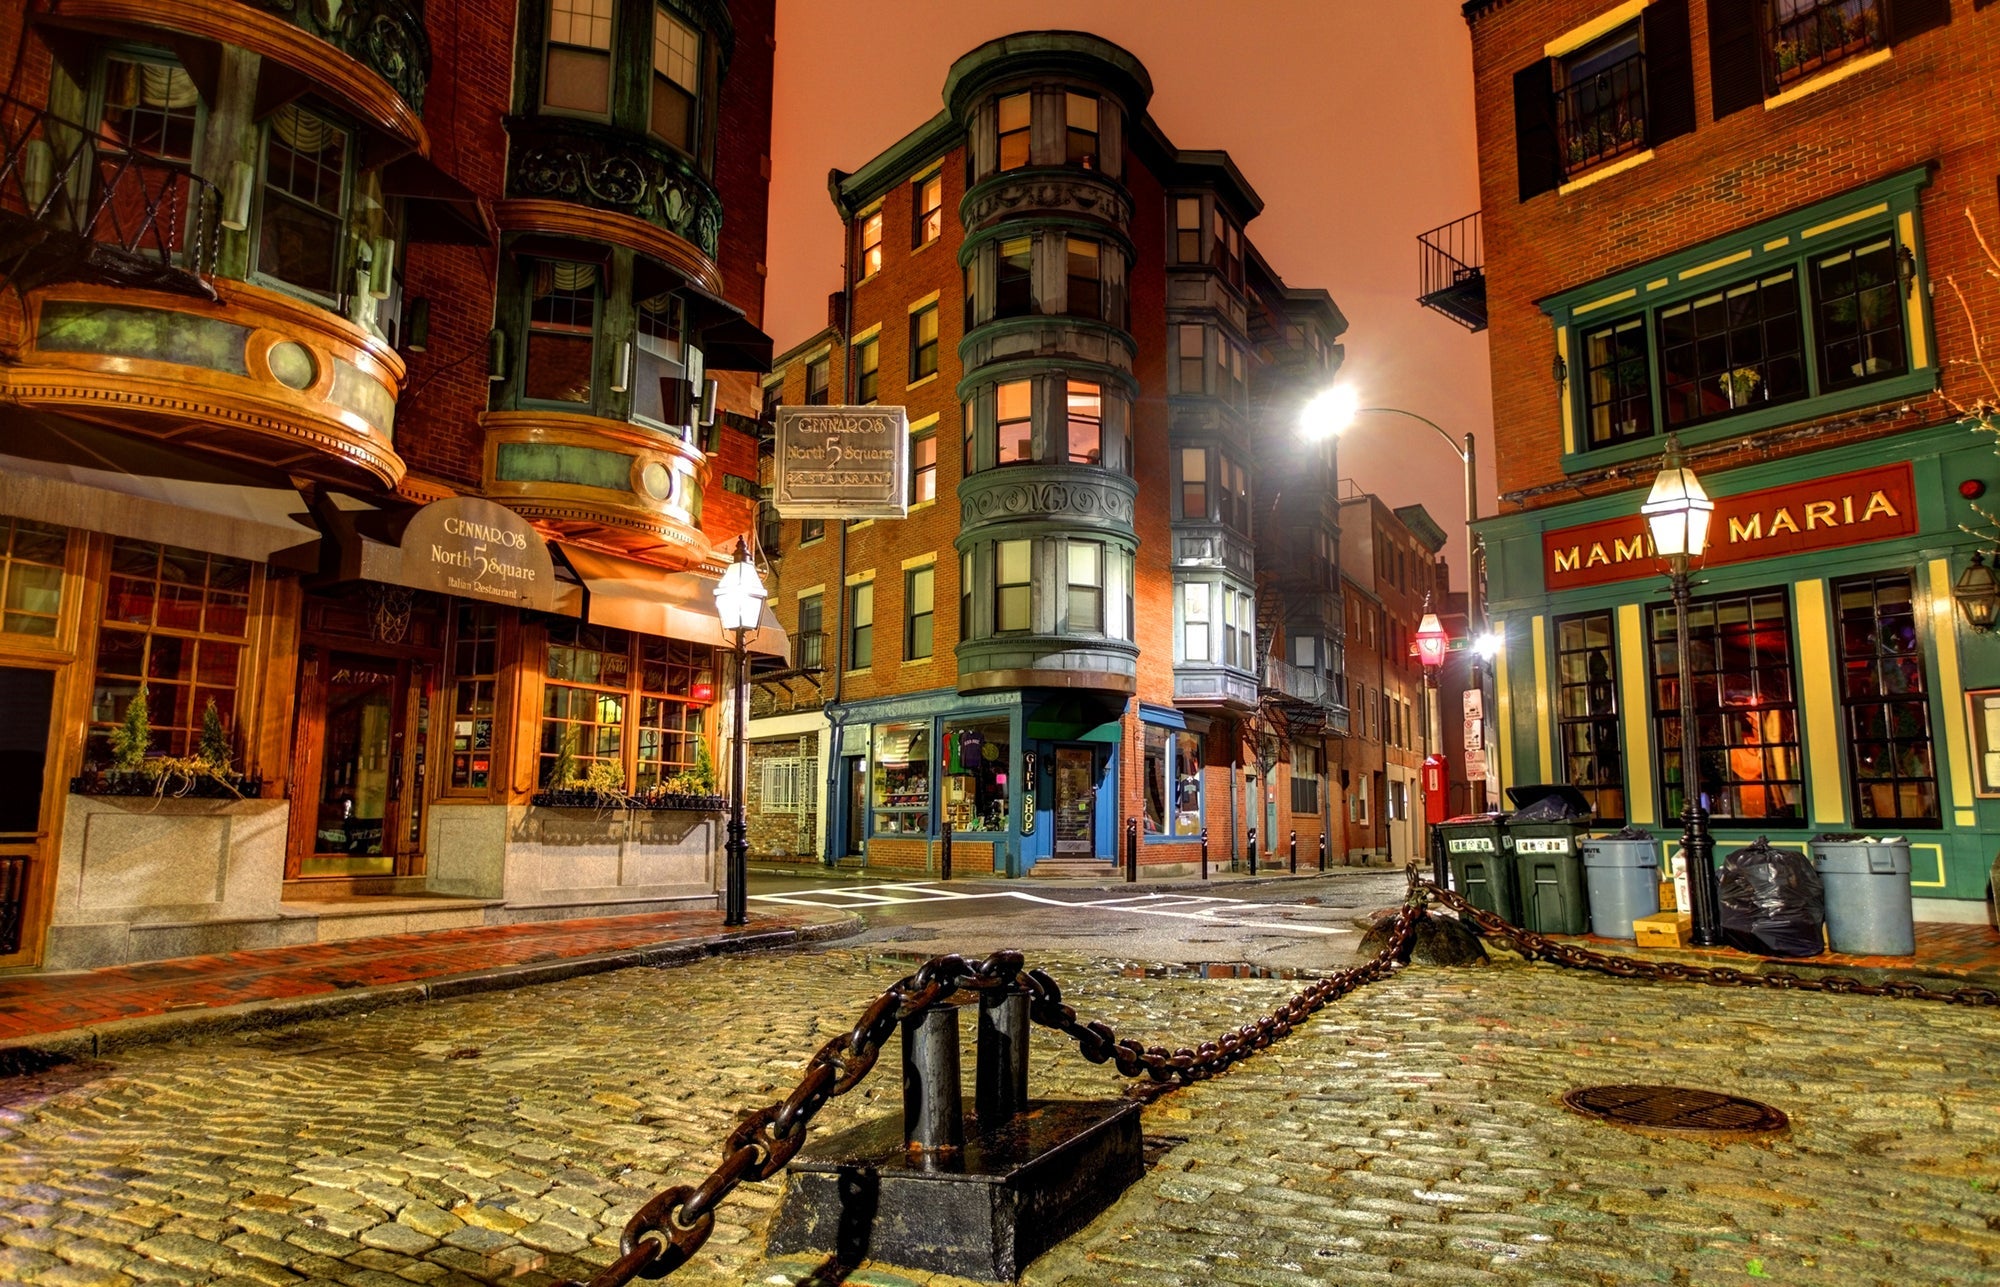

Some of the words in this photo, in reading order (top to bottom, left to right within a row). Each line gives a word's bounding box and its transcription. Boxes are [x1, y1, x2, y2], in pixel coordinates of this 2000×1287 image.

[798, 417, 886, 434] GENNARO'S
[787, 445, 826, 460] North
[826, 436, 842, 470] 5
[844, 446, 894, 465] Square
[787, 472, 891, 484] RESTAURANT
[444, 517, 527, 550] GENNARO'S
[1728, 490, 1898, 543] MARIA
[431, 544, 472, 569] North
[473, 543, 488, 581] 5
[488, 557, 536, 581] Square
[448, 577, 472, 591] Italian
[473, 581, 517, 599] Restaurant
[1026, 753, 1034, 790] GIFT
[1024, 794, 1034, 832] SHOP
